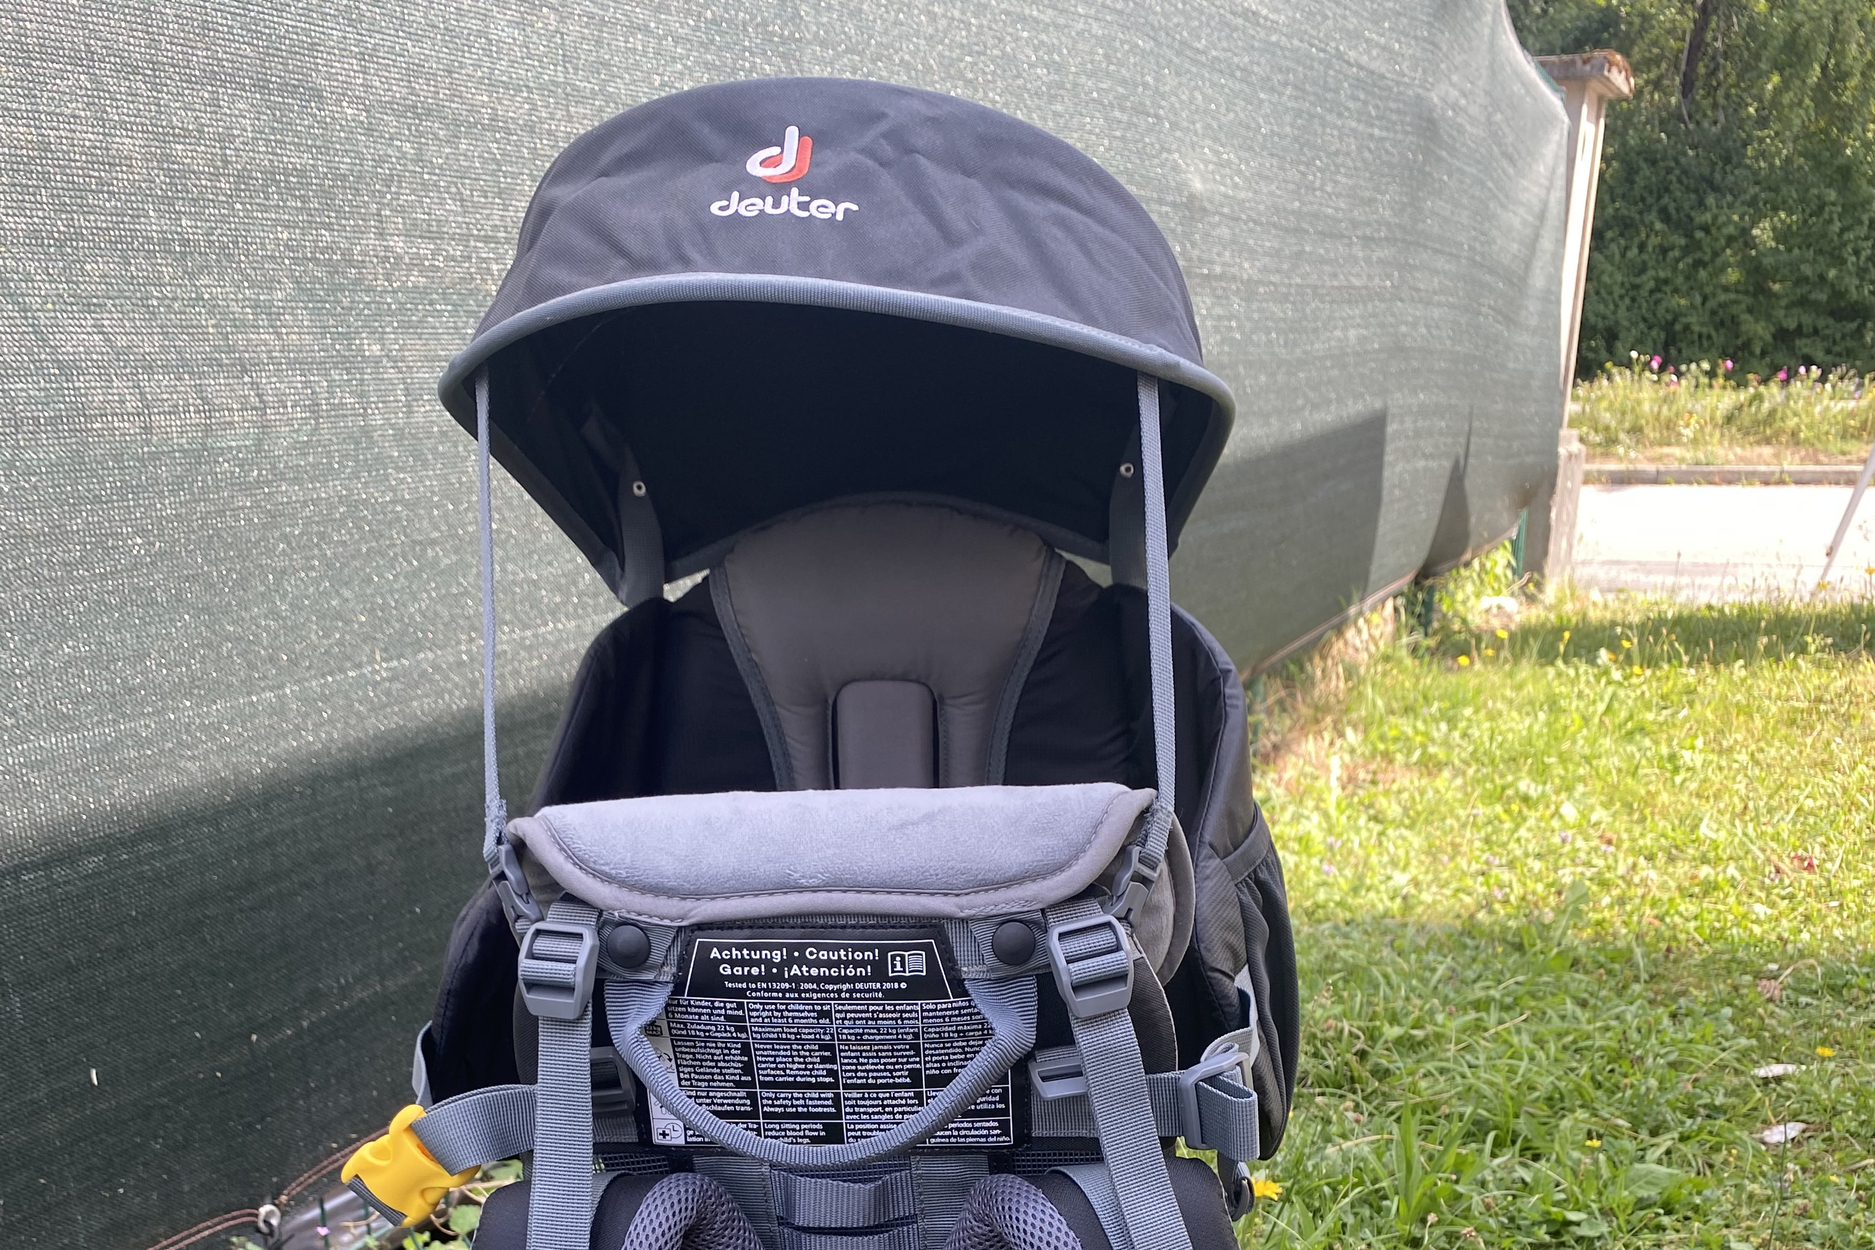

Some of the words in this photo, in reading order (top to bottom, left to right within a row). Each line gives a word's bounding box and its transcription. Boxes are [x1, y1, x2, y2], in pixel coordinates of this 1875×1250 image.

[710, 187, 859, 221] deuter
[710, 947, 787, 962] Achtung!
[806, 947, 879, 960] Caution!
[719, 964, 765, 975] Gare!
[784, 965, 871, 978] ¡Atención!
